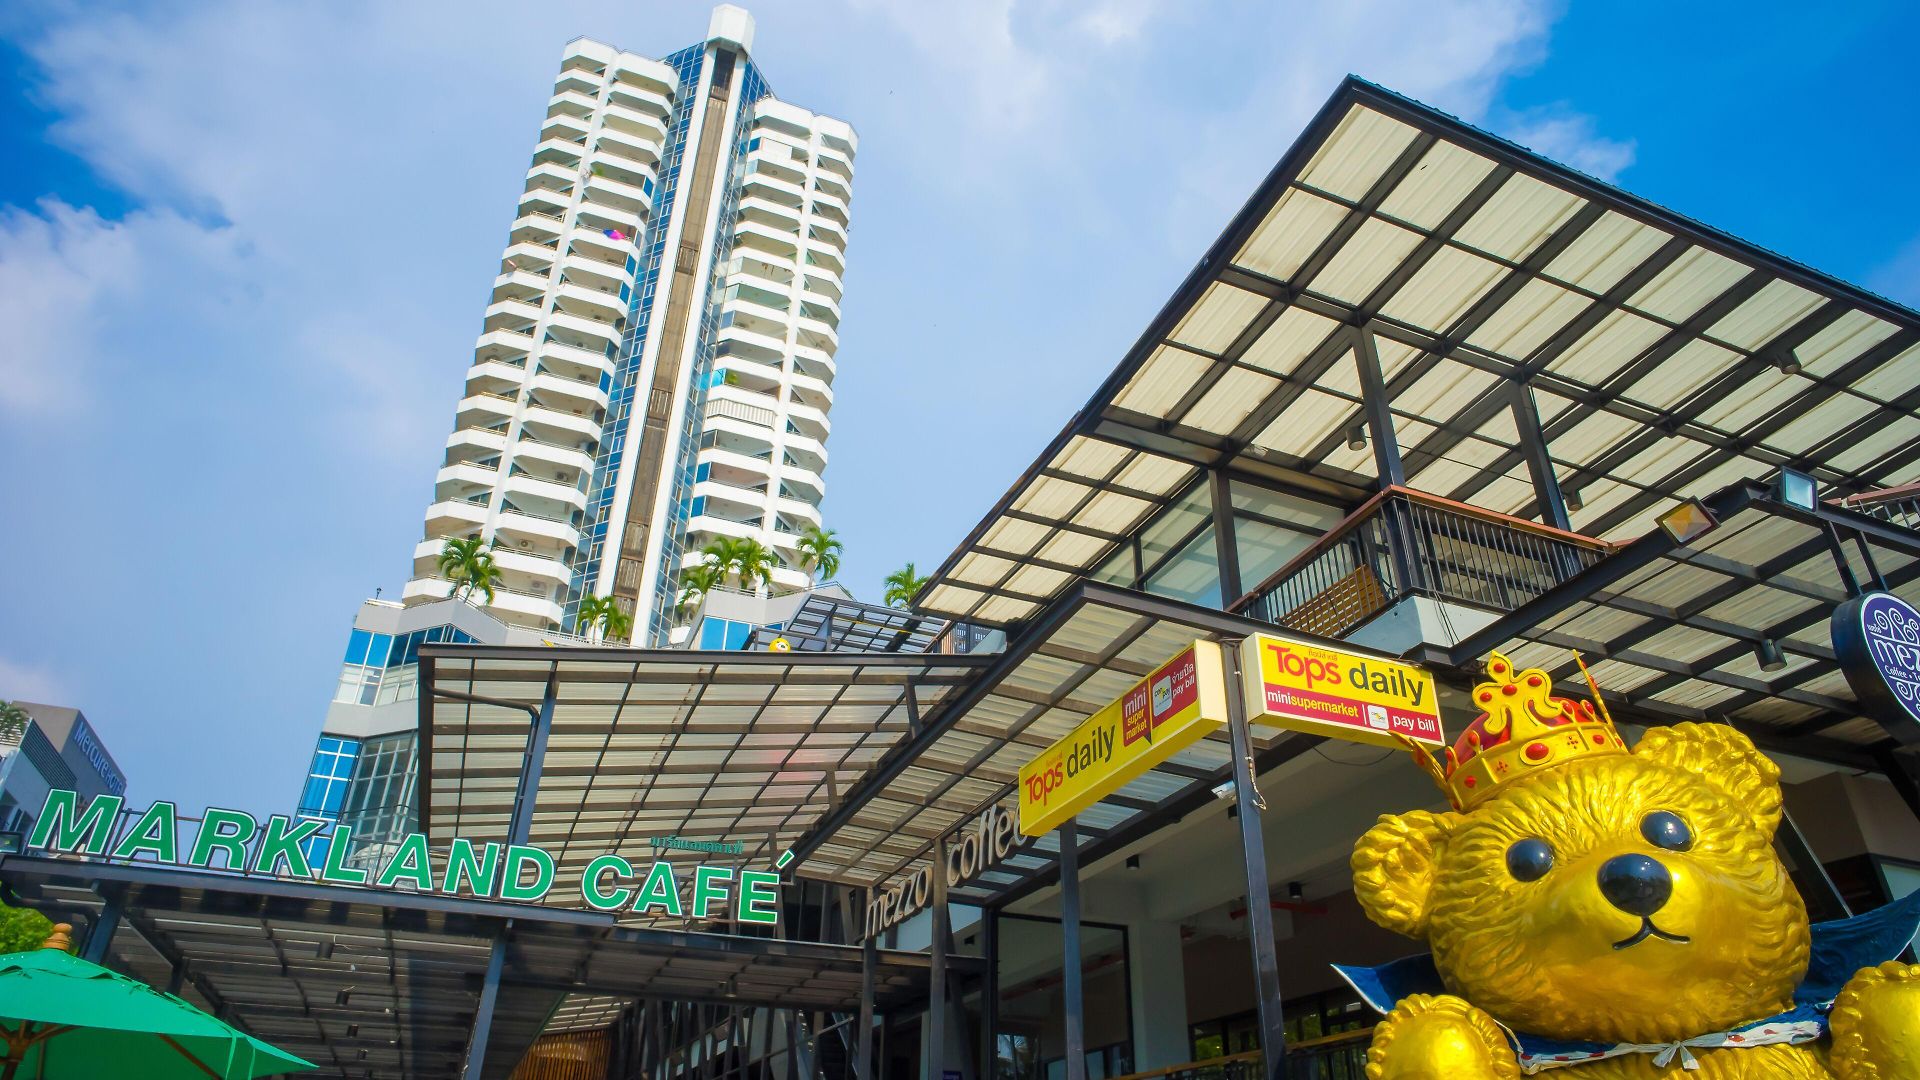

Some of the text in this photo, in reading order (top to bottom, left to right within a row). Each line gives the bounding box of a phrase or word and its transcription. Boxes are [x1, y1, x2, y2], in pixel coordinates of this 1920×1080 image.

[1267, 644, 1423, 706] Tops daily
[1884, 664, 1908, 678] Coffee
[1172, 675, 1195, 699] pay bill
[1125, 687, 1147, 718] mini
[1267, 690, 1359, 717] minisupermarket
[1126, 718, 1147, 740] market
[1127, 708, 1145, 727] super
[1392, 715, 1414, 731] pay
[1417, 717, 1435, 732] bill
[74, 721, 109, 778] Mercure
[1025, 723, 1115, 807] Tops daily
[27, 787, 796, 926] MARKLAND CAFÉ
[865, 864, 932, 919] mezzo
